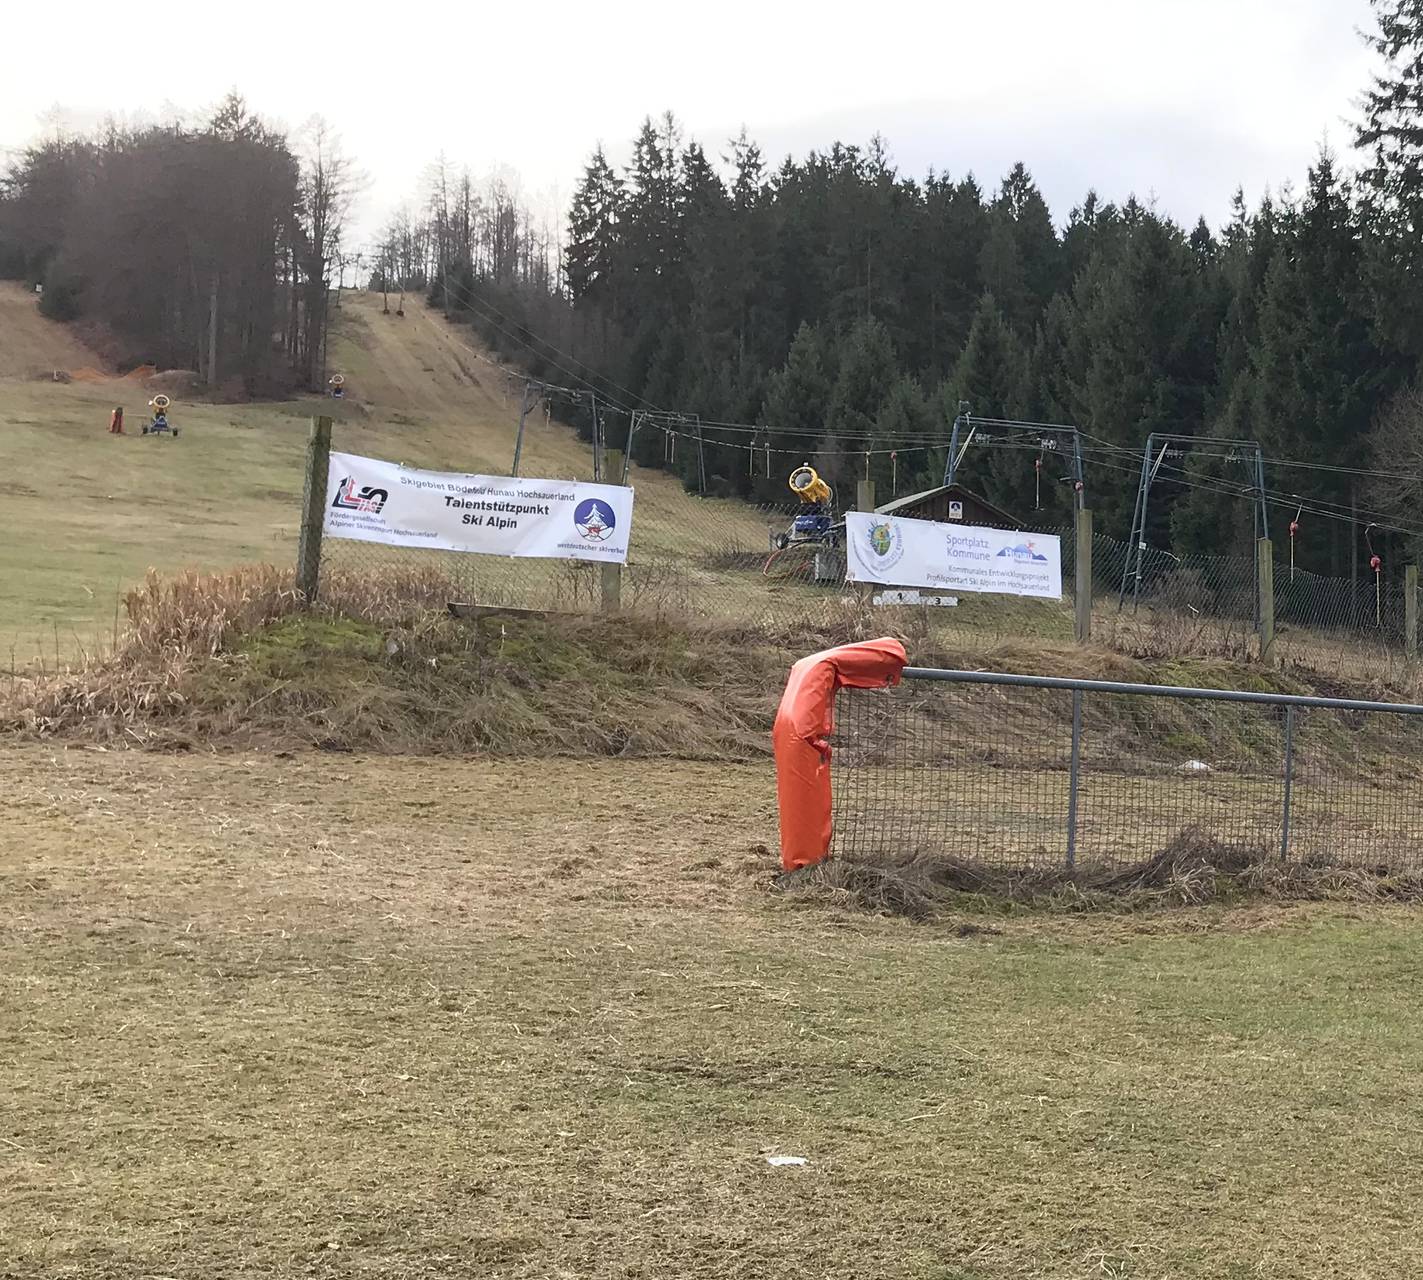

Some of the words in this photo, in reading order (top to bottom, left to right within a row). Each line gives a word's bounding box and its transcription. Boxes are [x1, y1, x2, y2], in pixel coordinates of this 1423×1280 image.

[400, 477, 445, 491] Skigebiet
[517, 490, 576, 501] Hochsauerland
[445, 496, 549, 515] Talentstützpunkt
[462, 514, 483, 526] Ski
[486, 516, 518, 529] Alpin
[946, 534, 989, 550] Sportplatz
[947, 547, 991, 561] Kommune
[948, 565, 988, 576] Kommunales
[935, 597, 941, 605] 3
